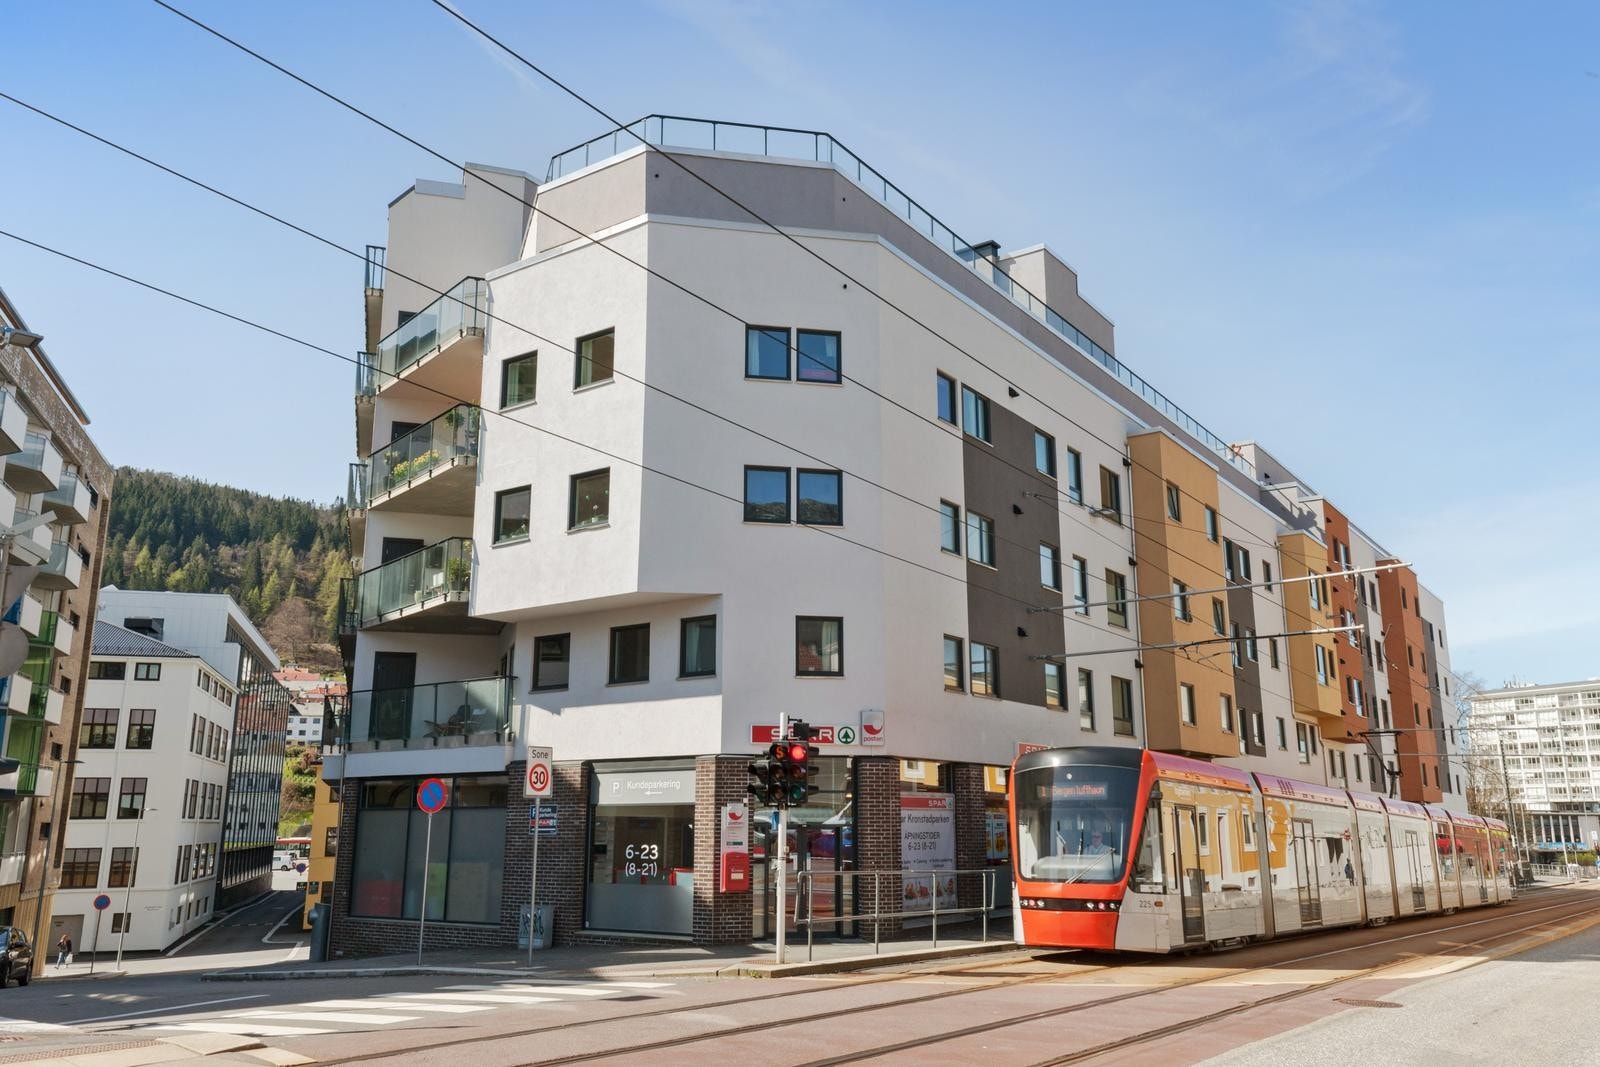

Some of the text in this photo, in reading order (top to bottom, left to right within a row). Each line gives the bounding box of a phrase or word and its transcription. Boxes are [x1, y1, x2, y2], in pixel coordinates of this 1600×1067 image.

[531, 749, 549, 759] Sone
[533, 770, 546, 785] 30
[612, 780, 681, 793] P Kundeparkering
[928, 799, 947, 807] SPAR
[625, 844, 659, 860] 6-23
[625, 861, 658, 878] (8-21)
